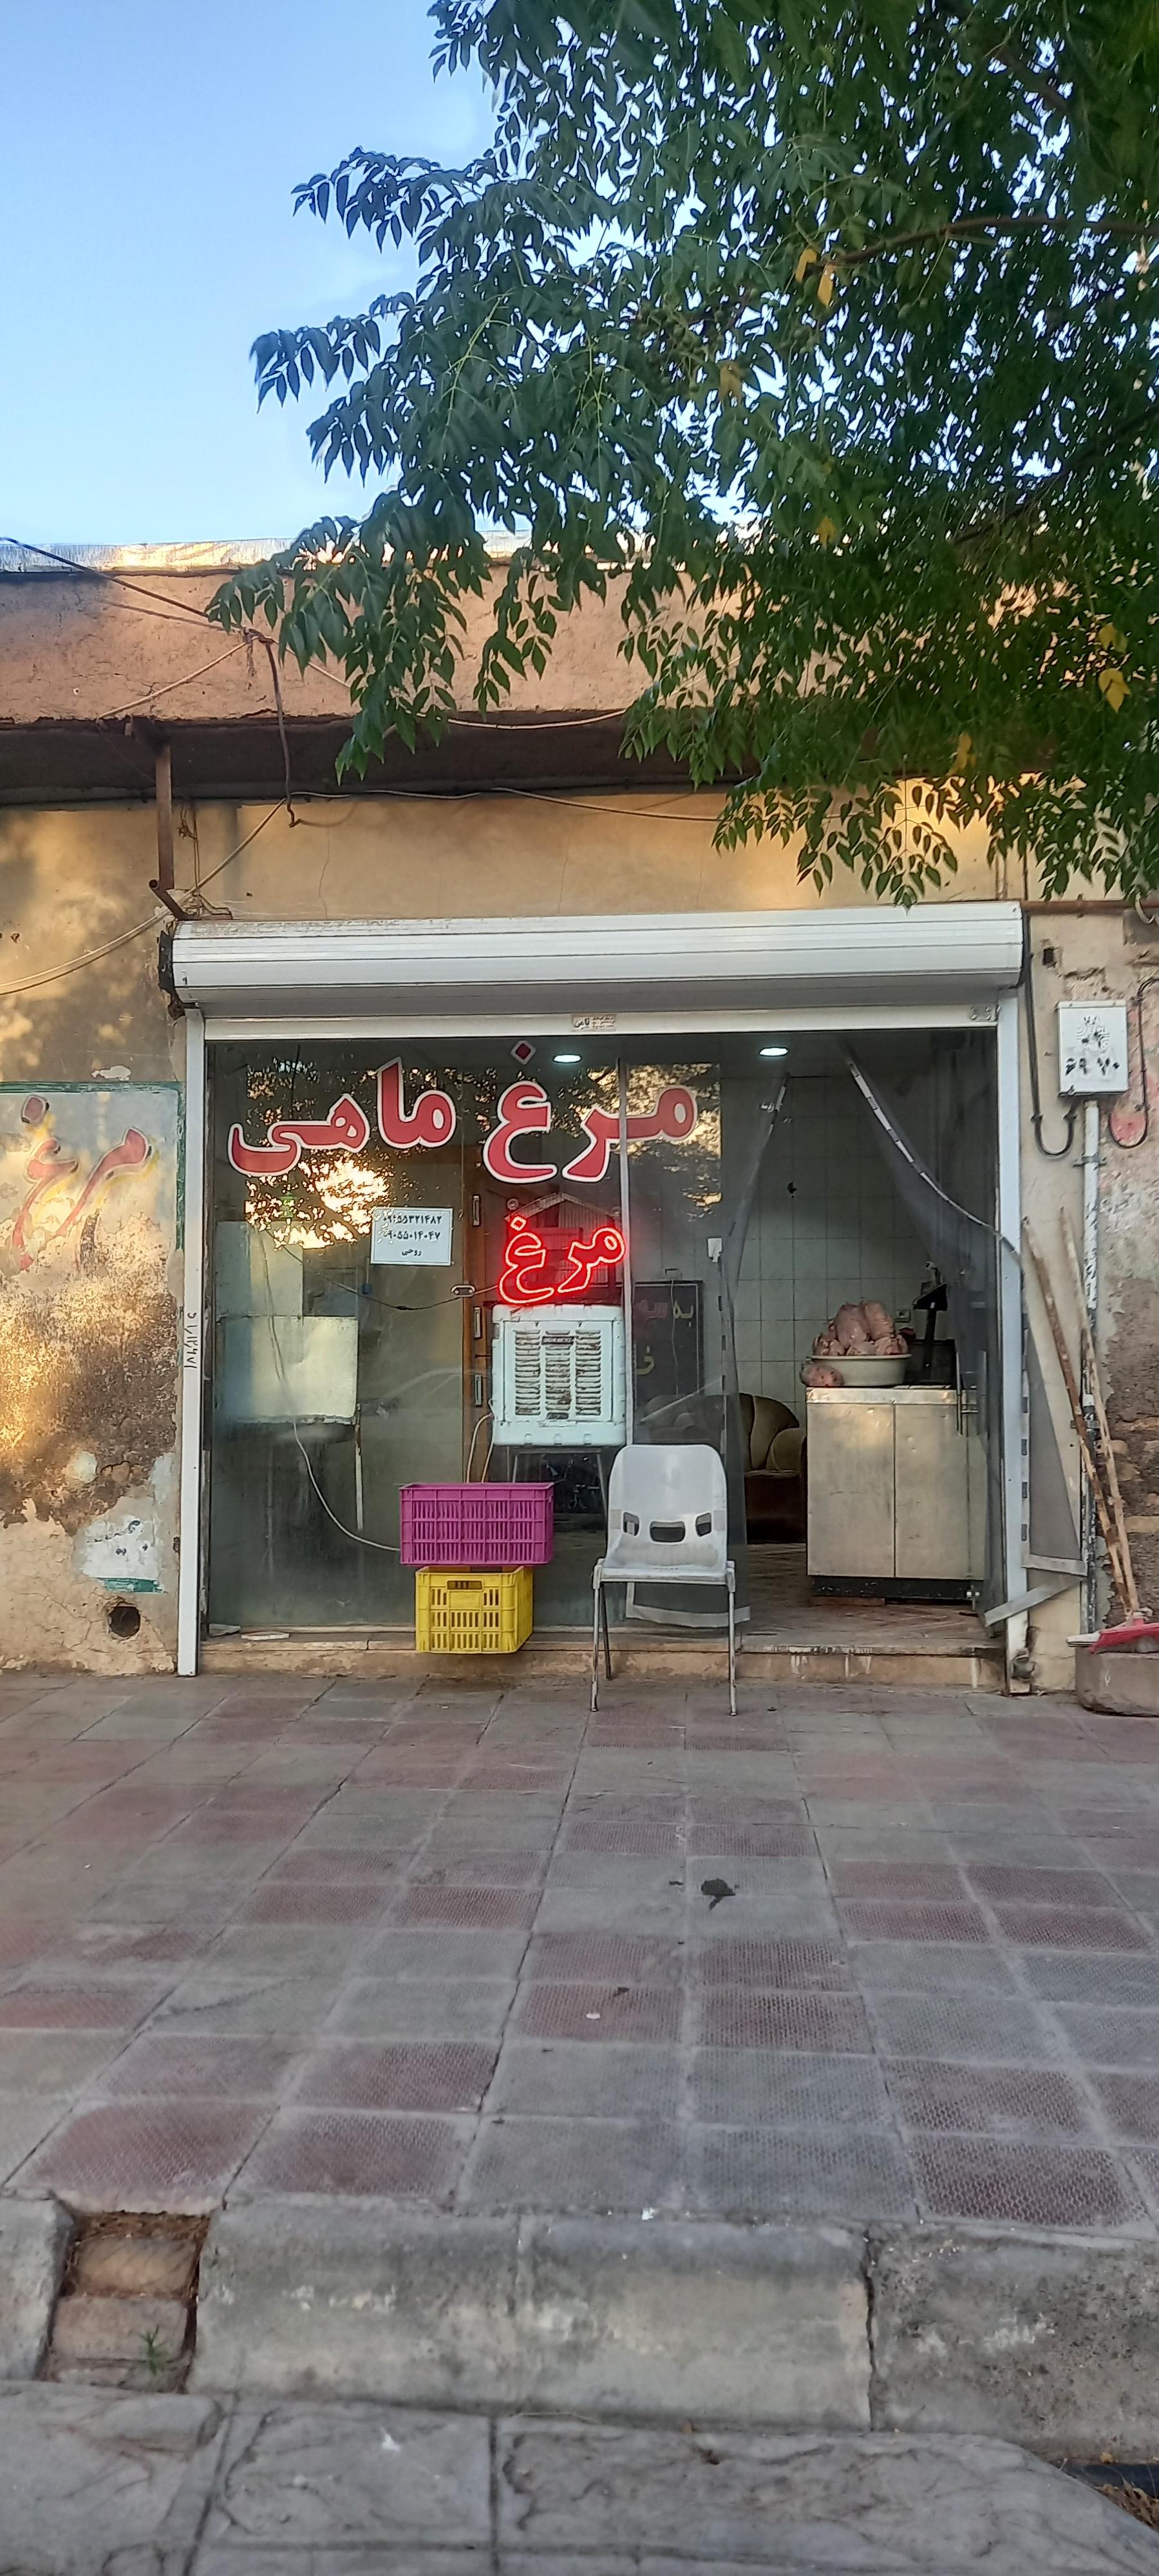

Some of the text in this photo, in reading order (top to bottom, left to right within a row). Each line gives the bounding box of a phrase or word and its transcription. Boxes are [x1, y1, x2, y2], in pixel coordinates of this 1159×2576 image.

[227, 1040, 698, 1184] مرغ ماهی
[384, 1229, 441, 1240] ۹۰۵۵۰۱۴۰۴۷
[401, 1248, 422, 1256] روحی
[498, 1215, 626, 1304] مرغ
